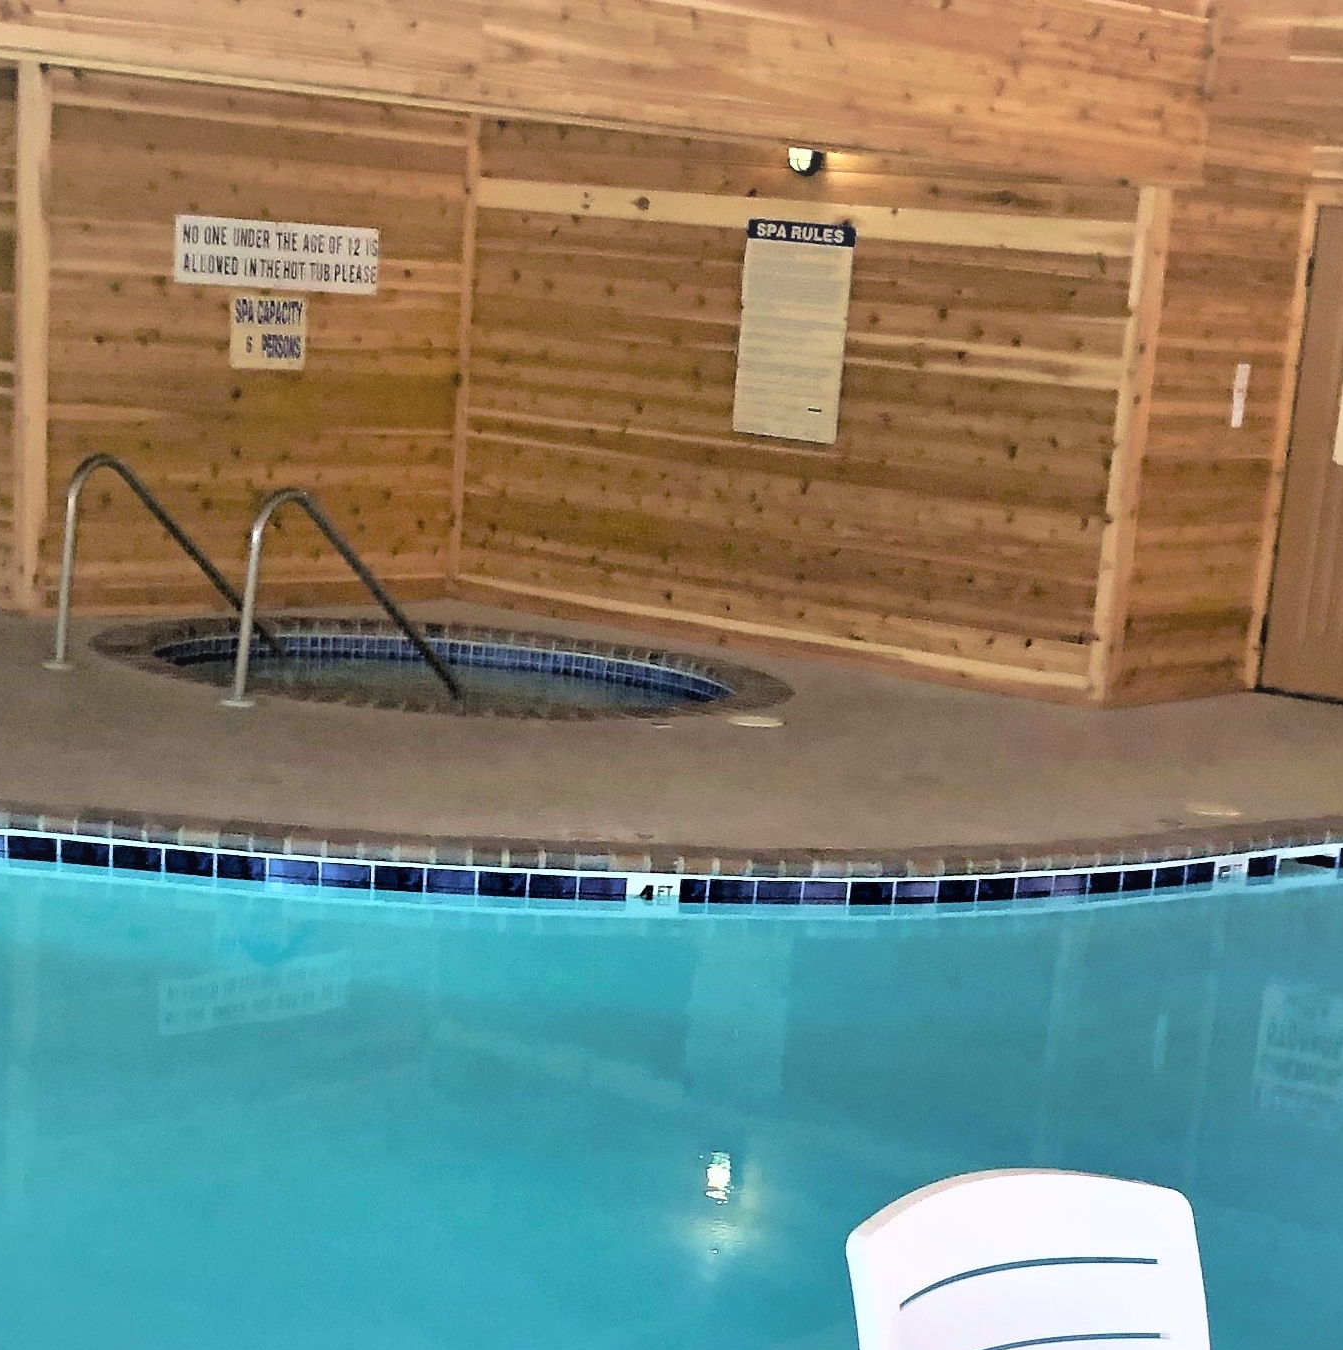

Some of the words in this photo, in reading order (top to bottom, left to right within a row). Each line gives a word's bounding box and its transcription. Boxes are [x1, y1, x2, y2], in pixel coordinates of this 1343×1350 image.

[183, 224, 199, 244] NO
[204, 225, 227, 246] ONE
[233, 227, 270, 248] UNDER
[276, 232, 297, 251] THE
[303, 233, 325, 254] AGE
[329, 235, 342, 254] OF
[348, 237, 360, 256] 12
[366, 237, 378, 257] IS
[756, 222, 787, 239] SPA
[791, 225, 845, 244] RULES
[184, 253, 238, 275] ALLOWED
[244, 257, 257, 277] IN
[260, 258, 281, 278] THE
[284, 261, 305, 280] HOT
[310, 262, 330, 282] TUB
[334, 263, 377, 284] PLEASE
[235, 298, 254, 323] SPA
[258, 300, 303, 325] CAPACITY
[262, 333, 301, 358] PERSONS
[638, 885, 654, 900] 4
